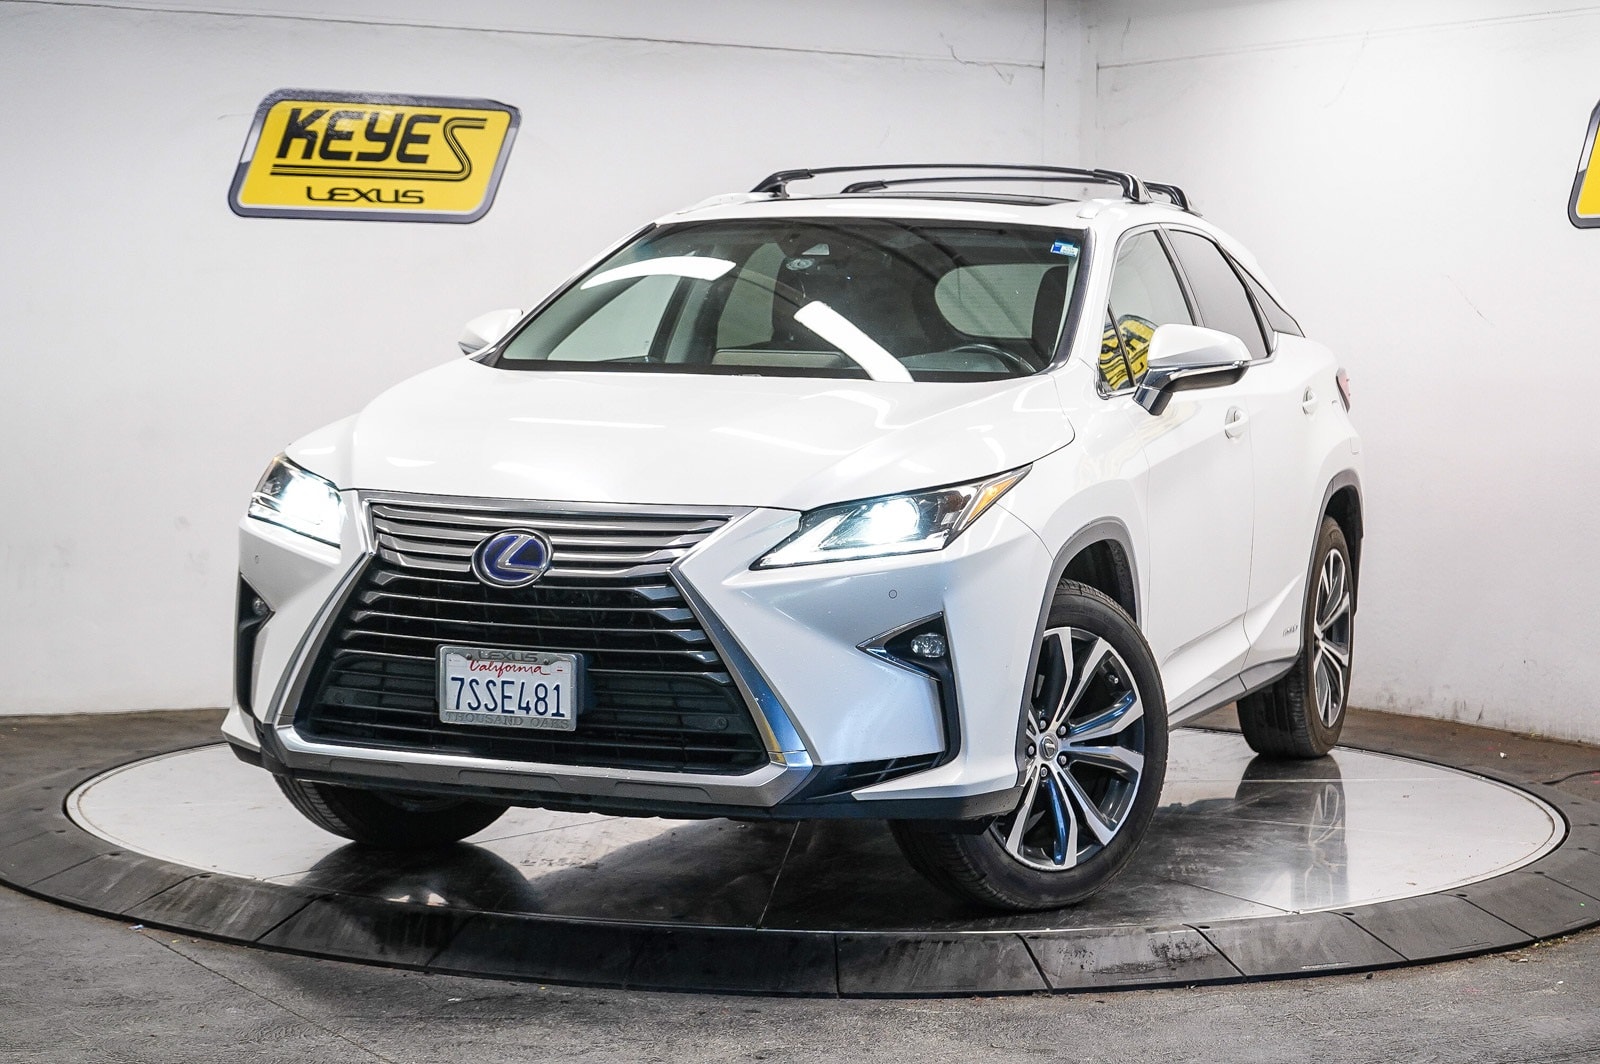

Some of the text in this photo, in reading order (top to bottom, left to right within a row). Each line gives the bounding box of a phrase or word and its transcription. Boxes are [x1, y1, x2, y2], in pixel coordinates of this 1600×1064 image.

[273, 108, 488, 181] KEYES
[306, 186, 425, 204] LEXUS
[478, 651, 538, 662] LEXUS
[470, 660, 550, 677] California
[451, 677, 565, 717] 7SSE481
[446, 712, 569, 729] THOUSAND OAKS
